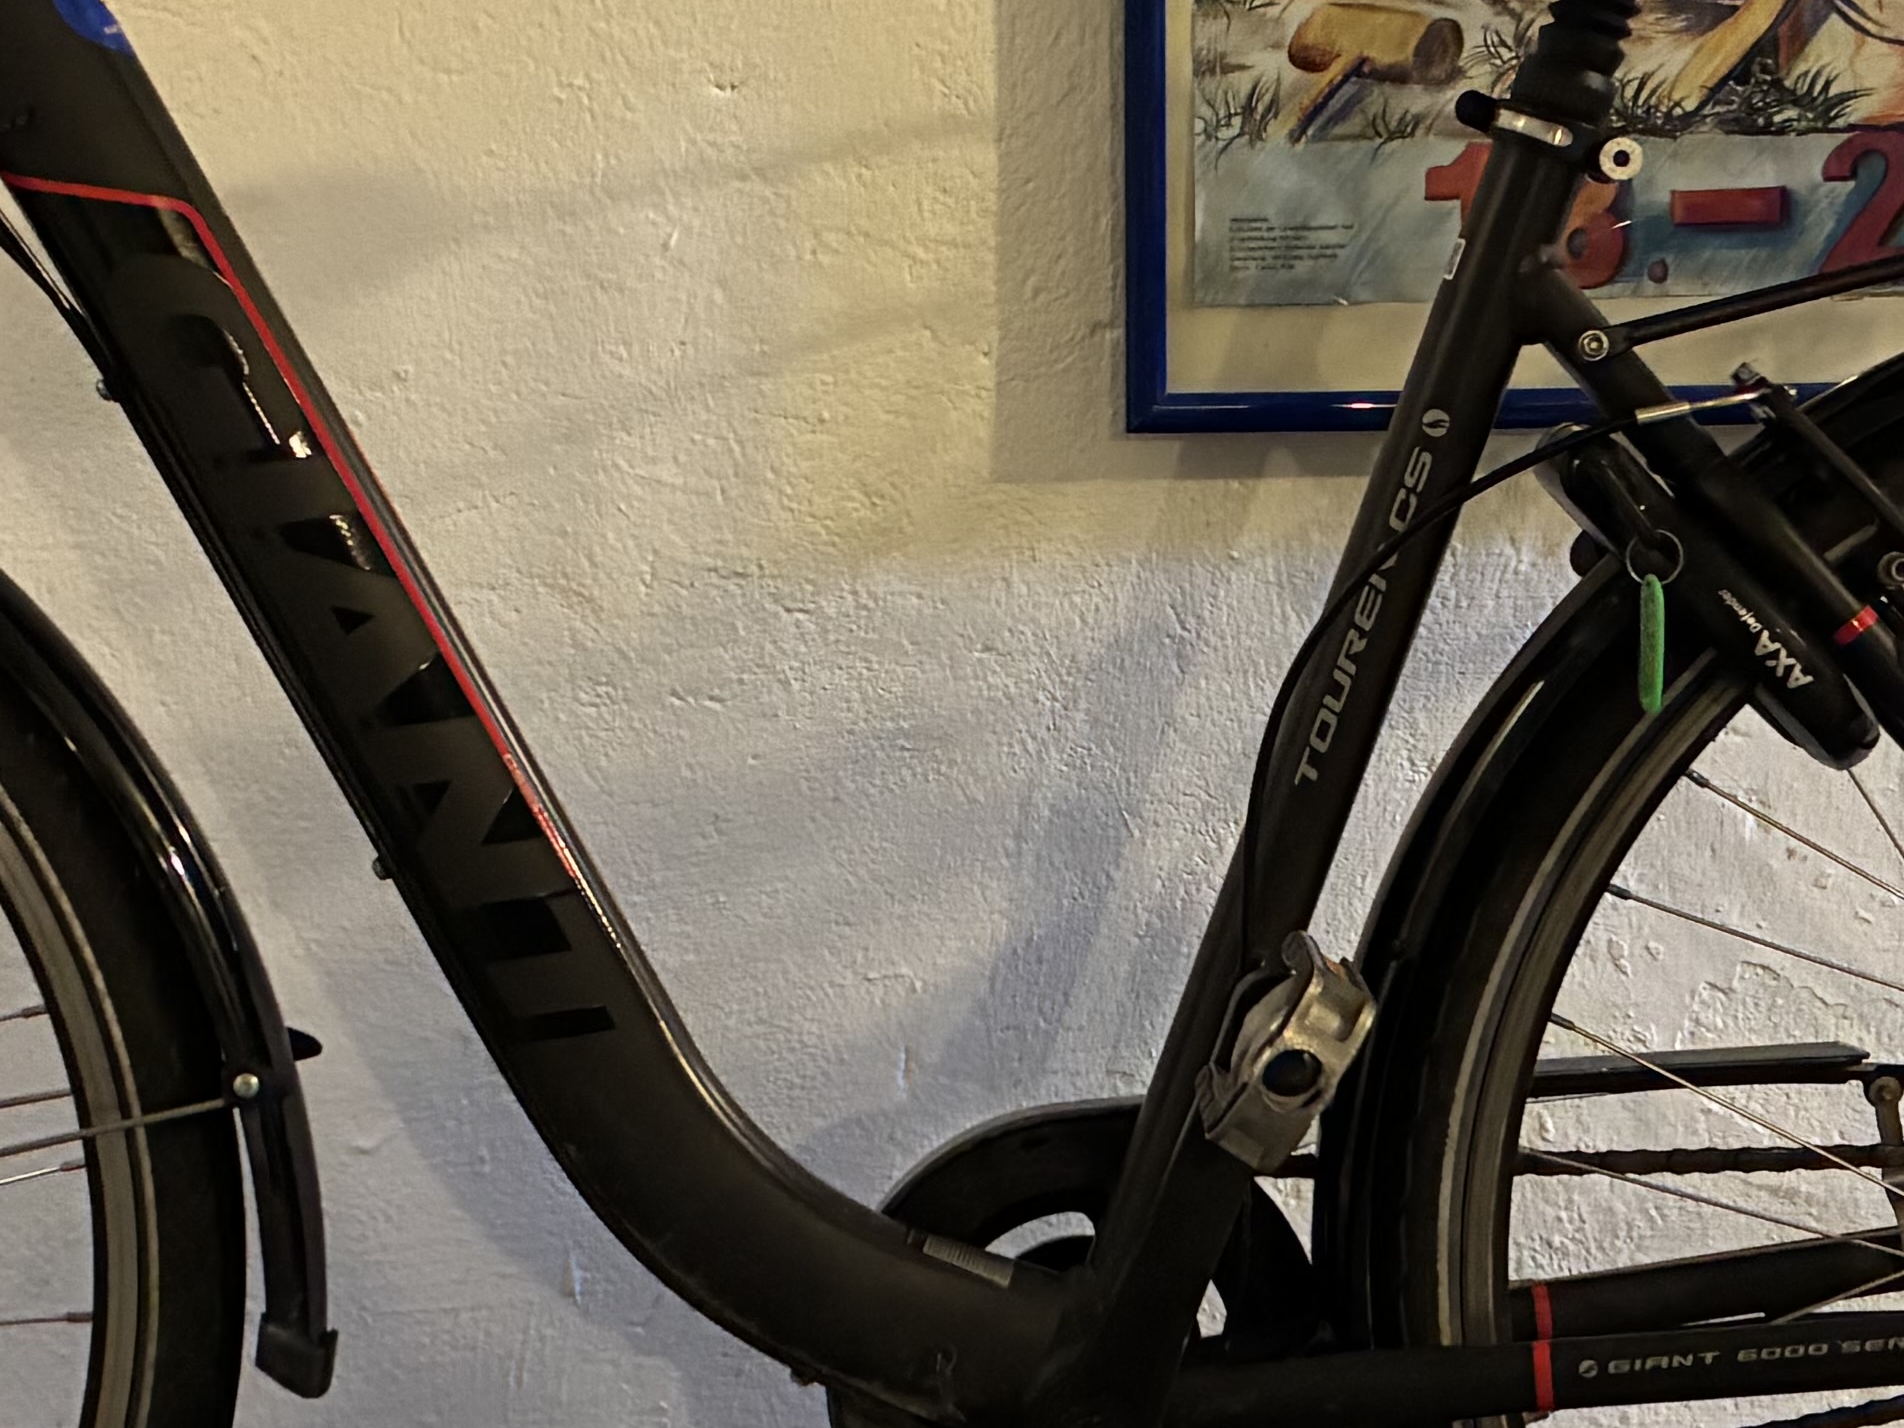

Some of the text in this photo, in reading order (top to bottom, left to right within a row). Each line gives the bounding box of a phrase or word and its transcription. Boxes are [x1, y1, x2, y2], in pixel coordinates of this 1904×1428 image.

[1389, 446, 1433, 532] CS
[101, 244, 648, 1029] GIANT
[1754, 629, 1814, 689] AXA
[1607, 1352, 1720, 1374] GIANT
[1737, 1342, 1829, 1362] 6000
